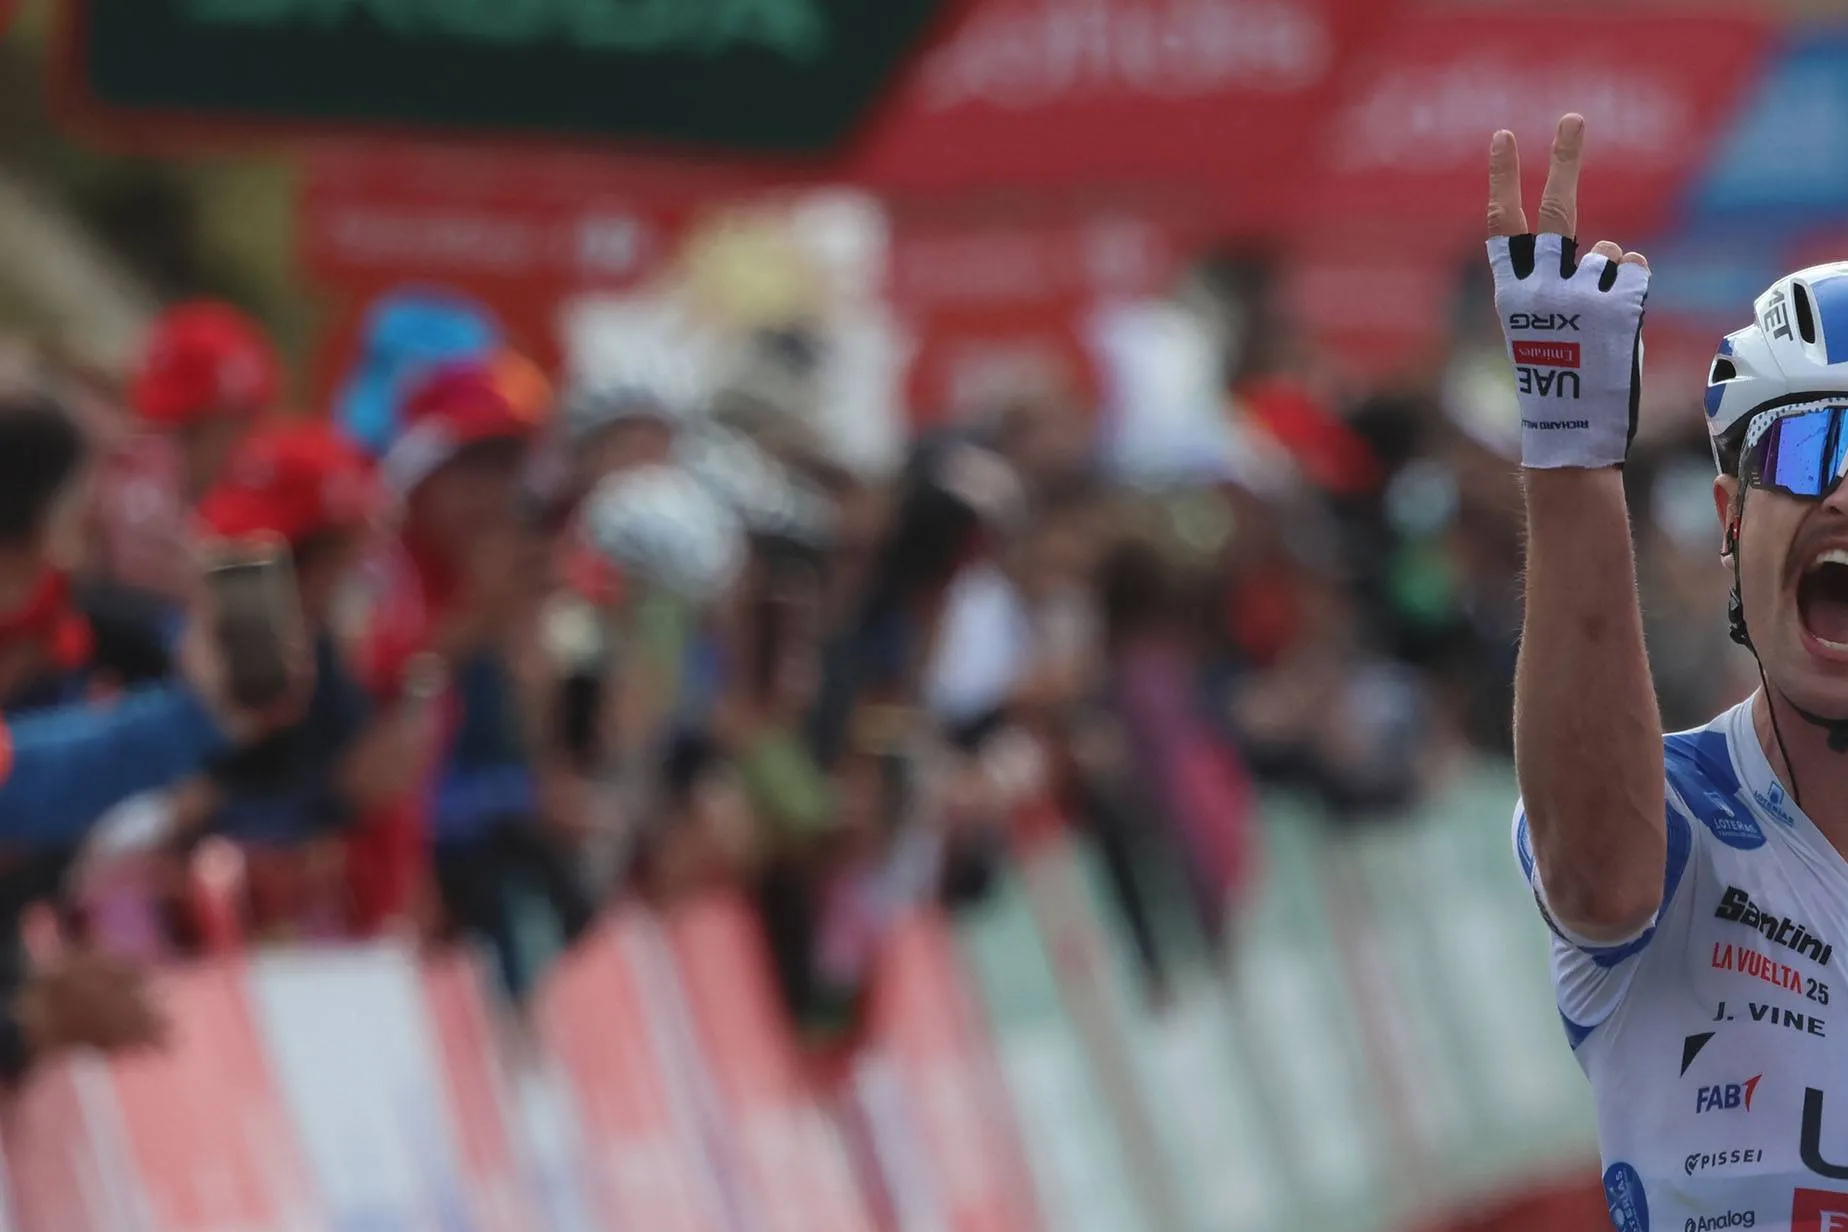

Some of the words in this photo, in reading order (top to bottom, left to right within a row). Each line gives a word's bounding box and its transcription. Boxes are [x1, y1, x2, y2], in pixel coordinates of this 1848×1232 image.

[1509, 313, 1581, 331] XRG
[1518, 346, 1575, 362] Emirates
[1516, 367, 1580, 399] UAE
[1538, 419, 1589, 430] RICHARD
[1714, 885, 1833, 966] Santini
[1712, 942, 1733, 970] LA
[1738, 946, 1803, 995] VUELTA
[1806, 978, 1829, 1006] 25
[1713, 1001, 1734, 1021] J.
[1749, 1002, 1826, 1038] VINE
[1701, 1149, 1763, 1170] PISSEI
